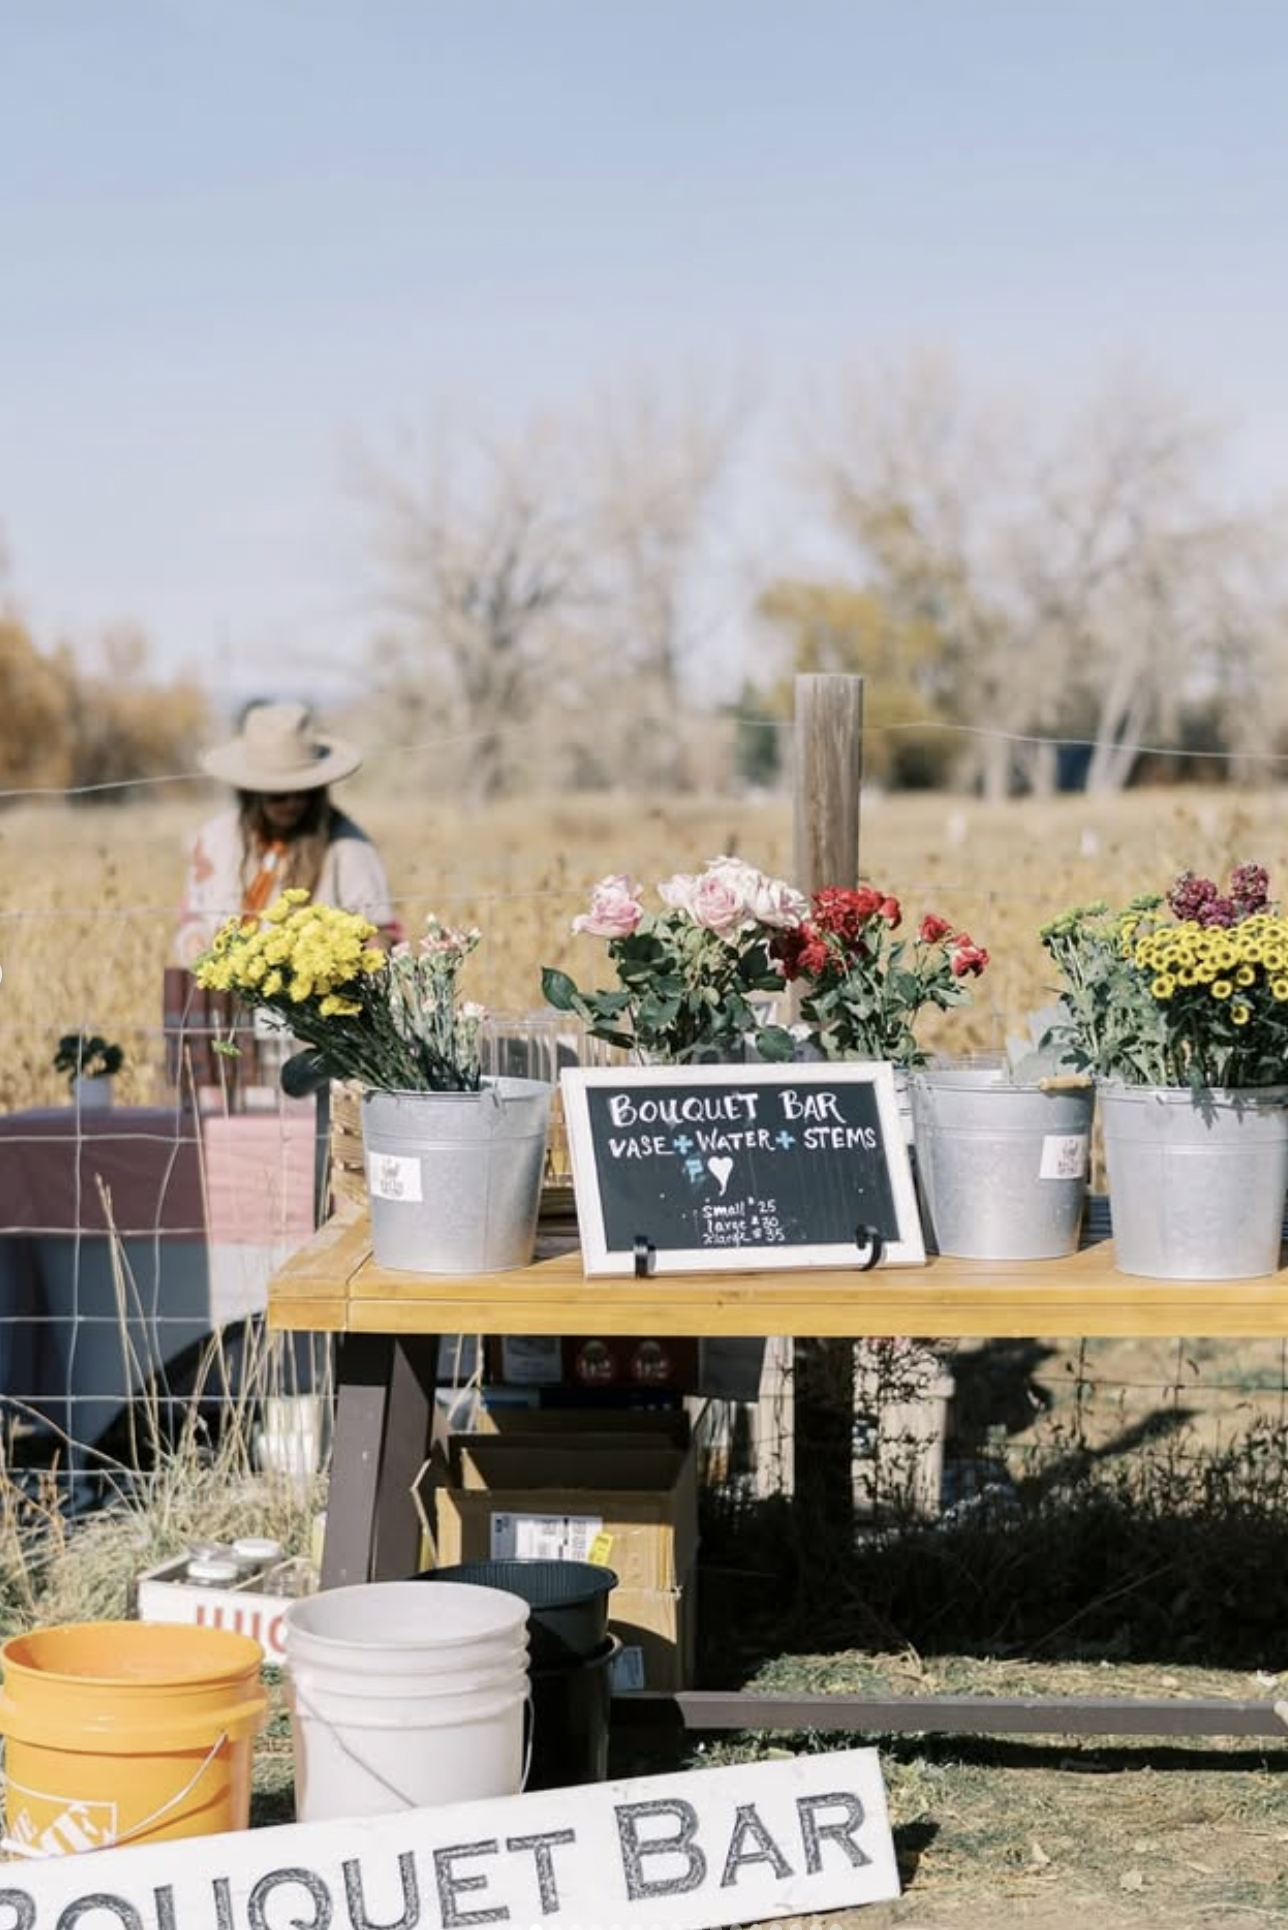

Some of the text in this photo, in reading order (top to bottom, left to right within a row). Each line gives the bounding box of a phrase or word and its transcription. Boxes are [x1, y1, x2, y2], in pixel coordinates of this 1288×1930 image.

[609, 1089, 846, 1127] BOUQUET BAR
[609, 1136, 674, 1158] VASE
[696, 1128, 775, 1151] WATER
[804, 1127, 876, 1149] STEMS
[614, 1792, 873, 1901] BAR
